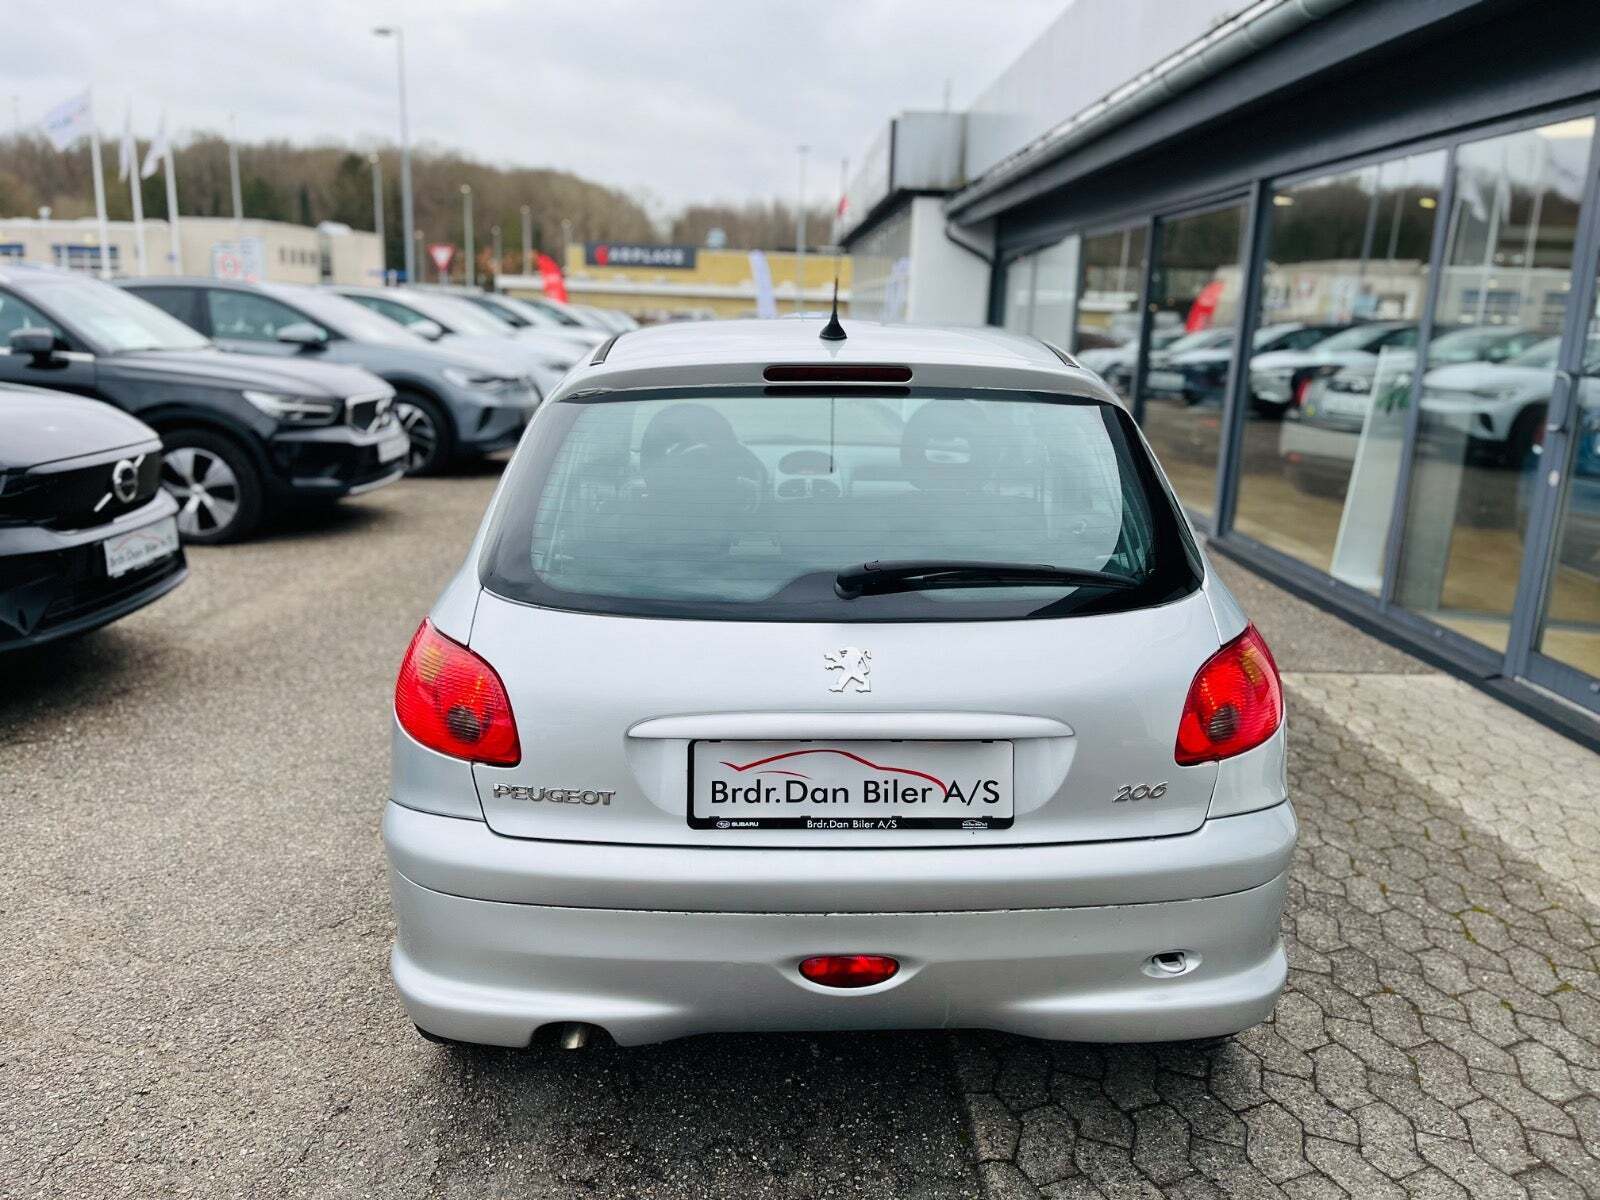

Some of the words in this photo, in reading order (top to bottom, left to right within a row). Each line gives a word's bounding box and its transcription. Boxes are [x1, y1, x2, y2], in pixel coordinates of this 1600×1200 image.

[493, 783, 616, 805] PEUGEOT
[711, 779, 849, 804] Brdr.Dan
[863, 779, 932, 804] Biler
[943, 779, 1000, 806] A/S
[1112, 780, 1168, 803] 206
[806, 819, 849, 829] Brdr.Dan
[852, 819, 875, 829] Biler
[877, 819, 897, 829] A/S
